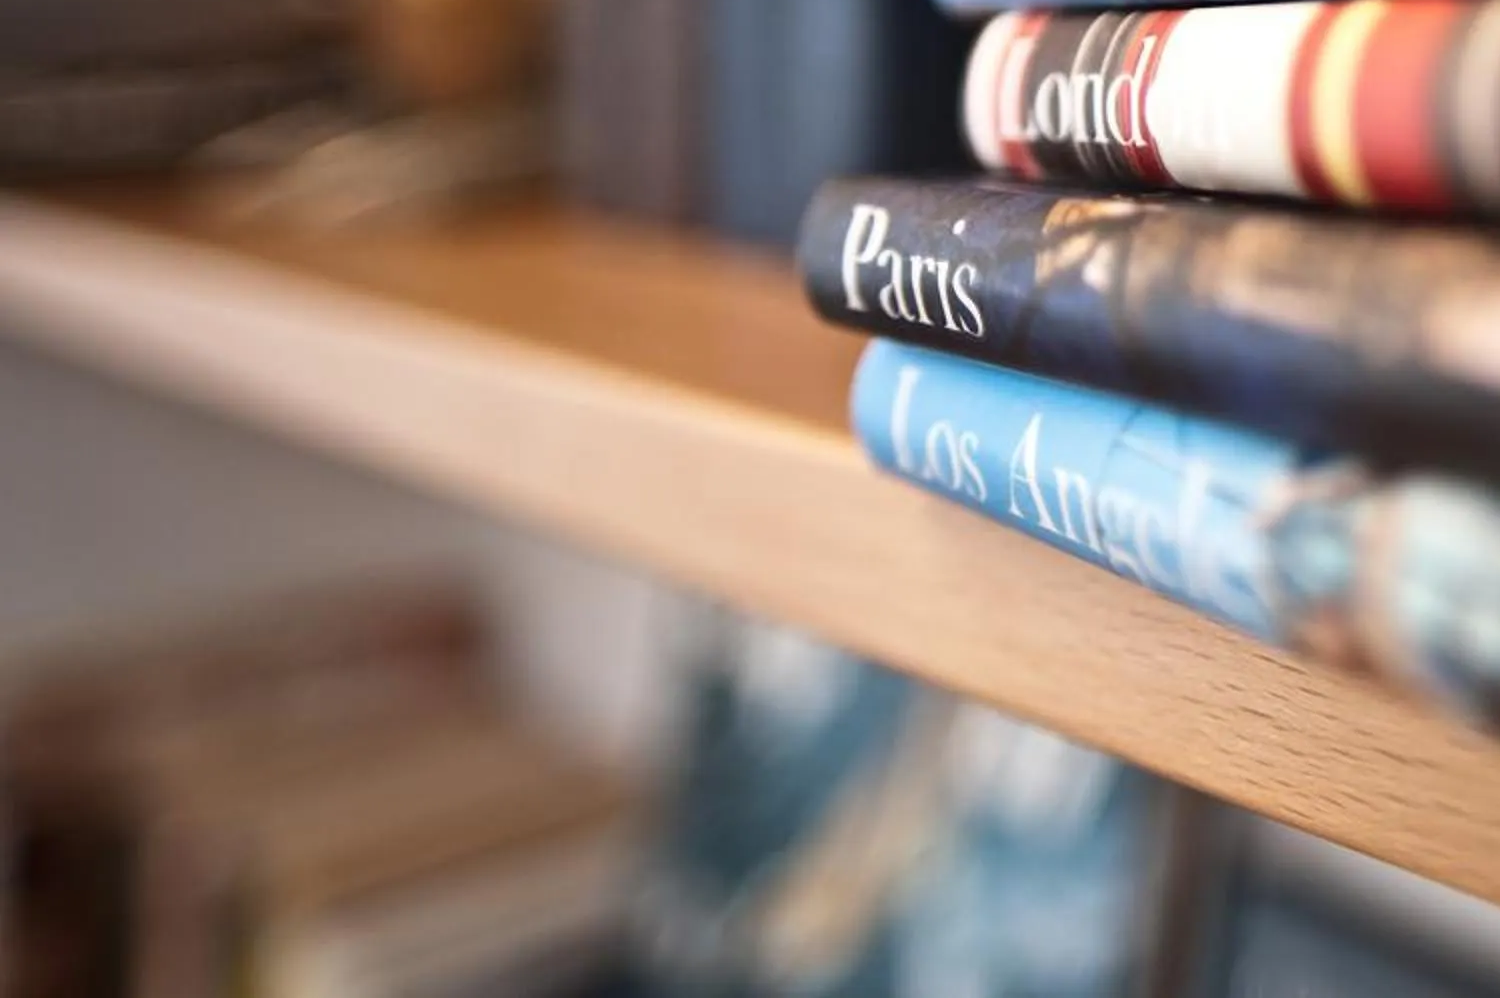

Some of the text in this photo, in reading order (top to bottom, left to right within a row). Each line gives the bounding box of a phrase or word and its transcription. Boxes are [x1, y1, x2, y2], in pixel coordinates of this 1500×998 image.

[1000, 35, 1234, 149] Lond
[841, 203, 985, 338] Paris
[890, 364, 1262, 602] Los Angel
